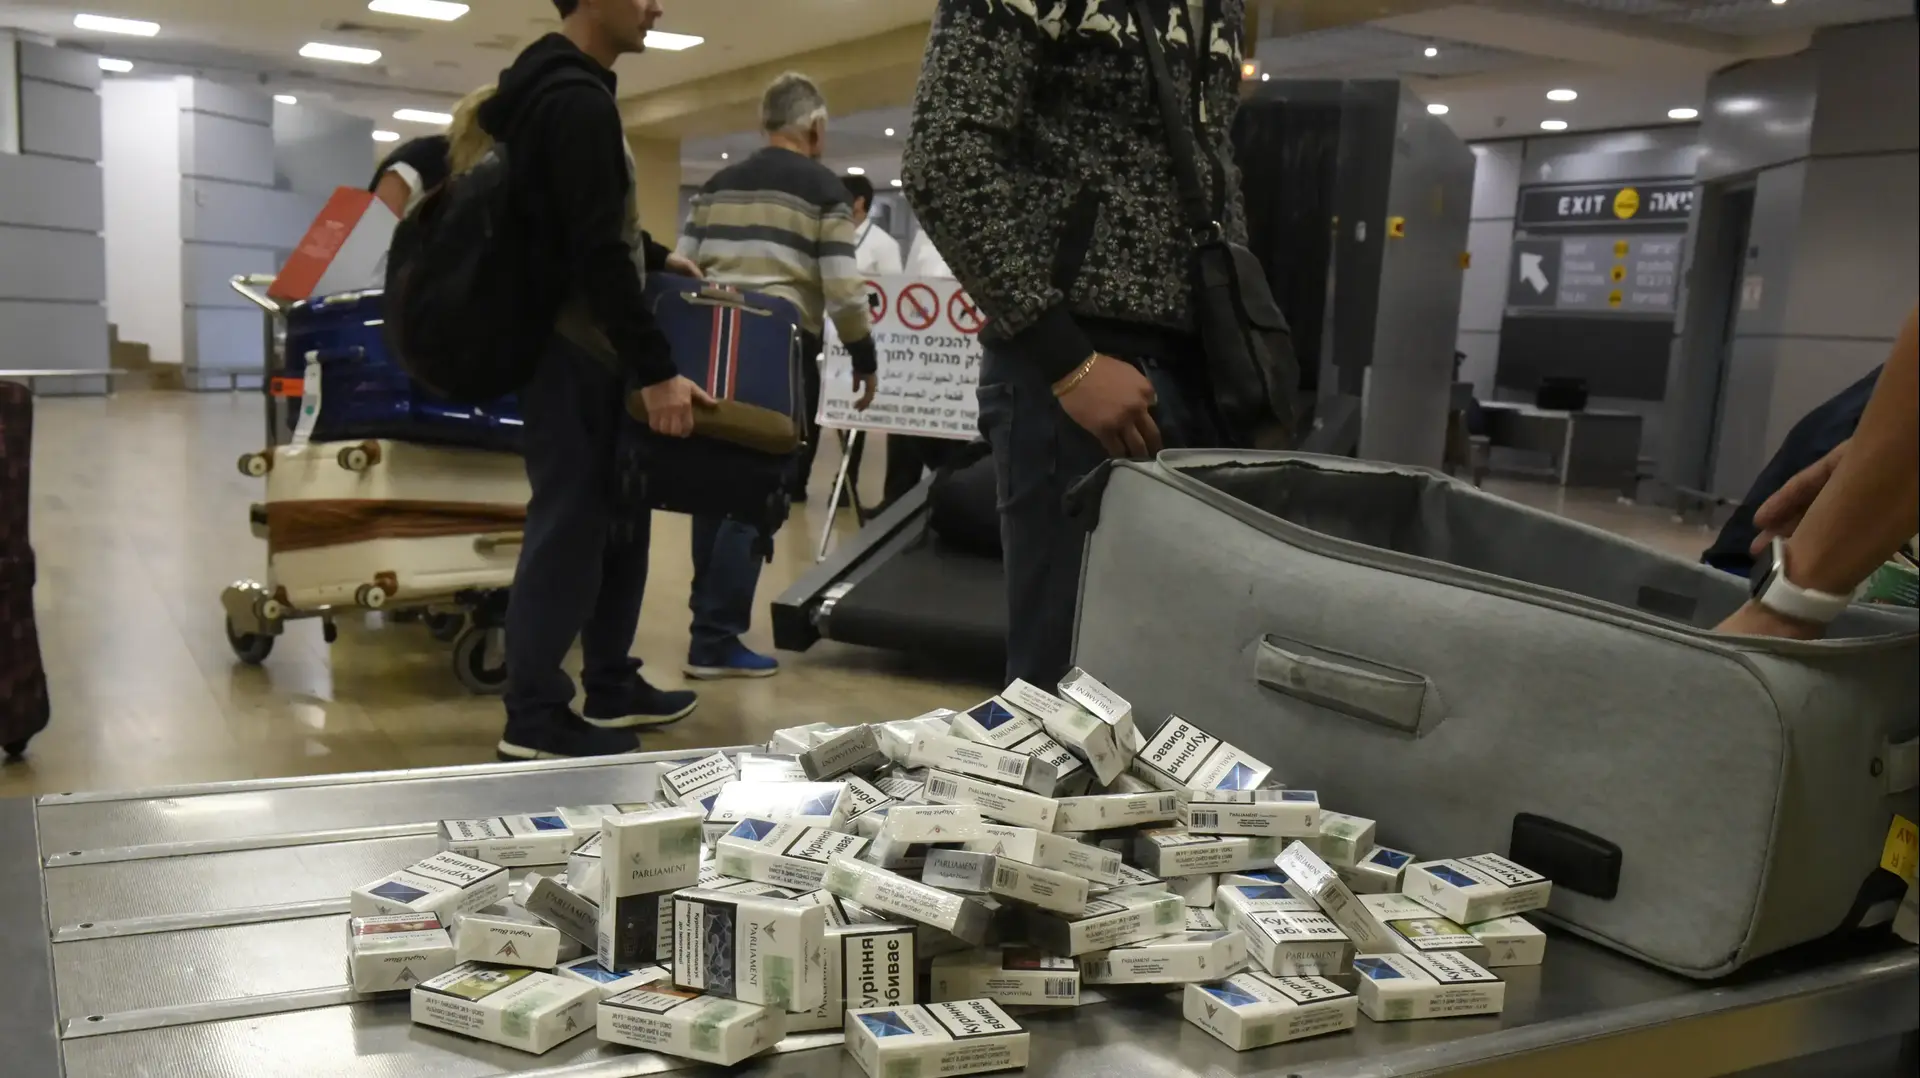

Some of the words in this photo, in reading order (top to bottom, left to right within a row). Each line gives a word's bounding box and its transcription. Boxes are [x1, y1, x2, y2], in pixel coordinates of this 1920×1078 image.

[1558, 195, 1605, 216] EXIT
[924, 334, 971, 349] להכניס
[884, 349, 914, 362] לתוך
[919, 353, 960, 366] מהגוף
[826, 411, 845, 421] NOT
[846, 413, 892, 425] ALLOWED
[895, 416, 907, 425] TO
[909, 418, 926, 427] PUT
[930, 420, 938, 428] IN
[942, 420, 958, 430] THE
[901, 405, 915, 414] OR
[917, 406, 942, 416] PART
[944, 408, 957, 417] OF
[989, 719, 1026, 741] PARLIAMENT
[822, 740, 865, 767] PARLIAMENT
[1152, 724, 1189, 762] вбиває
[1166, 732, 1210, 775] Куріння
[673, 757, 724, 781] вбиває
[677, 763, 734, 789] Куріння
[1201, 751, 1236, 789] PARLIAMENT
[800, 830, 831, 859] Куріння
[418, 861, 476, 883] Куріння
[436, 855, 489, 874] вбиває
[632, 864, 687, 879] PARLIAMENT
[934, 859, 977, 871] PARLIAMENT
[1467, 857, 1522, 884] Куріння
[1482, 855, 1534, 879] вбиває
[546, 891, 597, 927] PARLIAMENT
[513, 929, 533, 938] Night
[750, 922, 759, 987] PARLIAMENT
[1285, 951, 1337, 960] PARLIAMENT
[1440, 952, 1483, 978] вбиває
[1278, 975, 1318, 1000] Курін
[1299, 973, 1335, 994] вбив
[942, 1001, 982, 1035] Куріння
[968, 1000, 1005, 1029] вбиває
